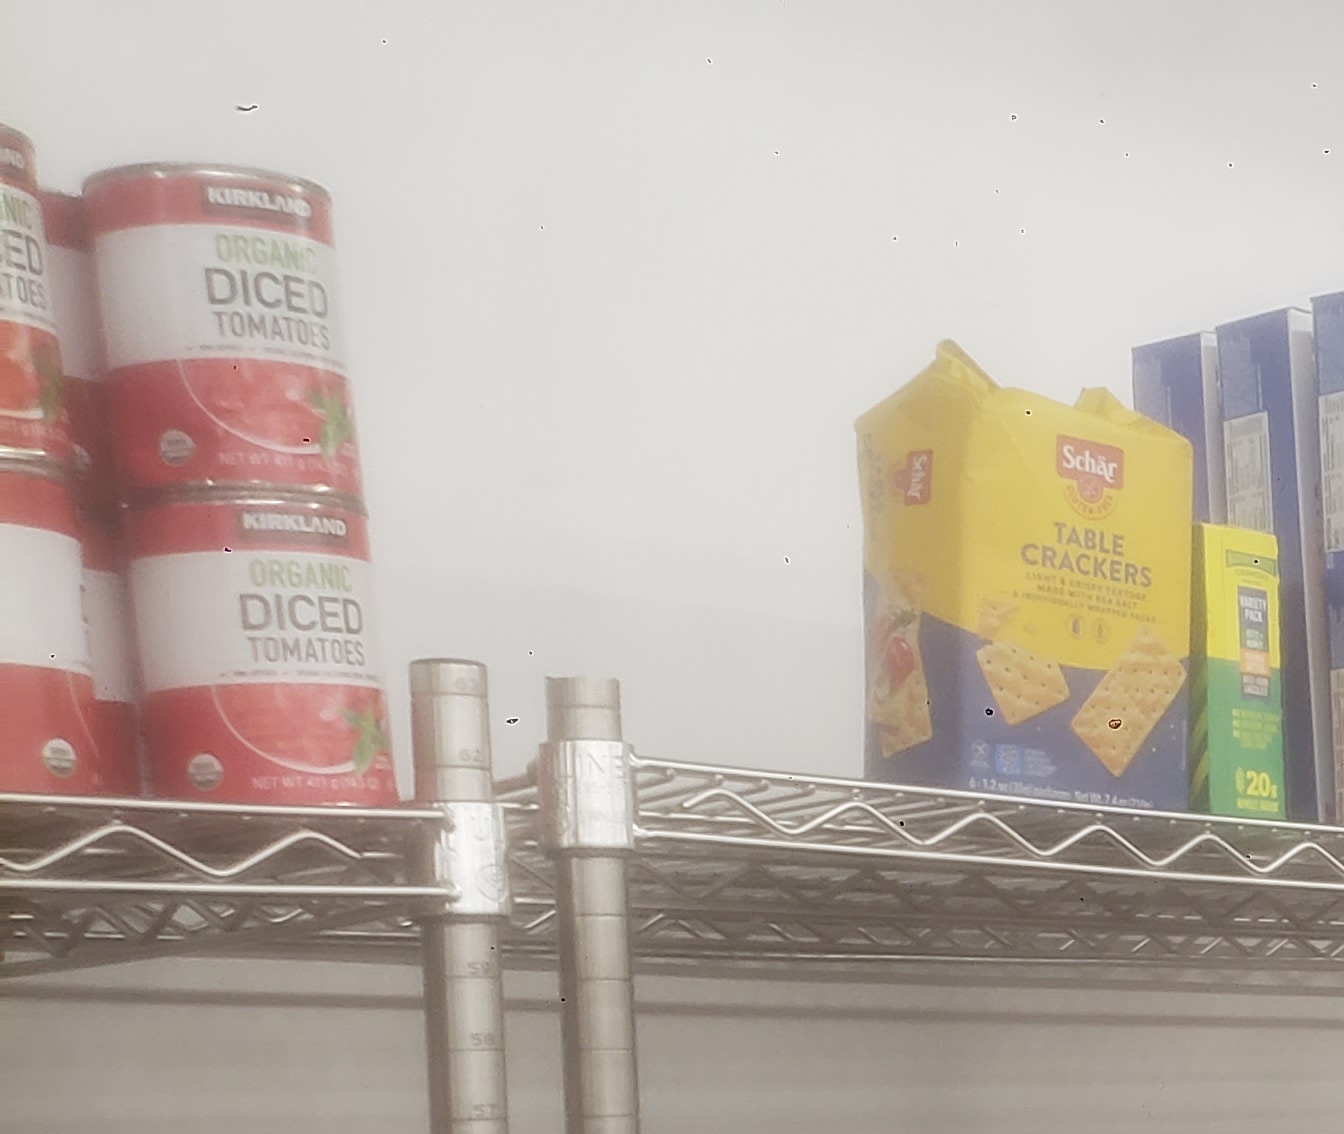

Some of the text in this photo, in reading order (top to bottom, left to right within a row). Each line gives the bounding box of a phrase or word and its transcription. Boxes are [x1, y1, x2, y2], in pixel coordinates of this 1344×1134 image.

[206, 186, 312, 218] KIRKLAND
[215, 233, 317, 274] ORGANIC
[204, 267, 329, 318] DICED
[212, 311, 331, 351] TOMATOES
[1062, 445, 1118, 483] Schär
[242, 513, 347, 537] KIRKLAND
[1054, 521, 1125, 557] TABLE
[250, 558, 353, 591] ORGANIC
[1020, 543, 1152, 588] CRACKERS
[239, 593, 363, 635] DICED
[247, 636, 366, 667] TOMATOES
